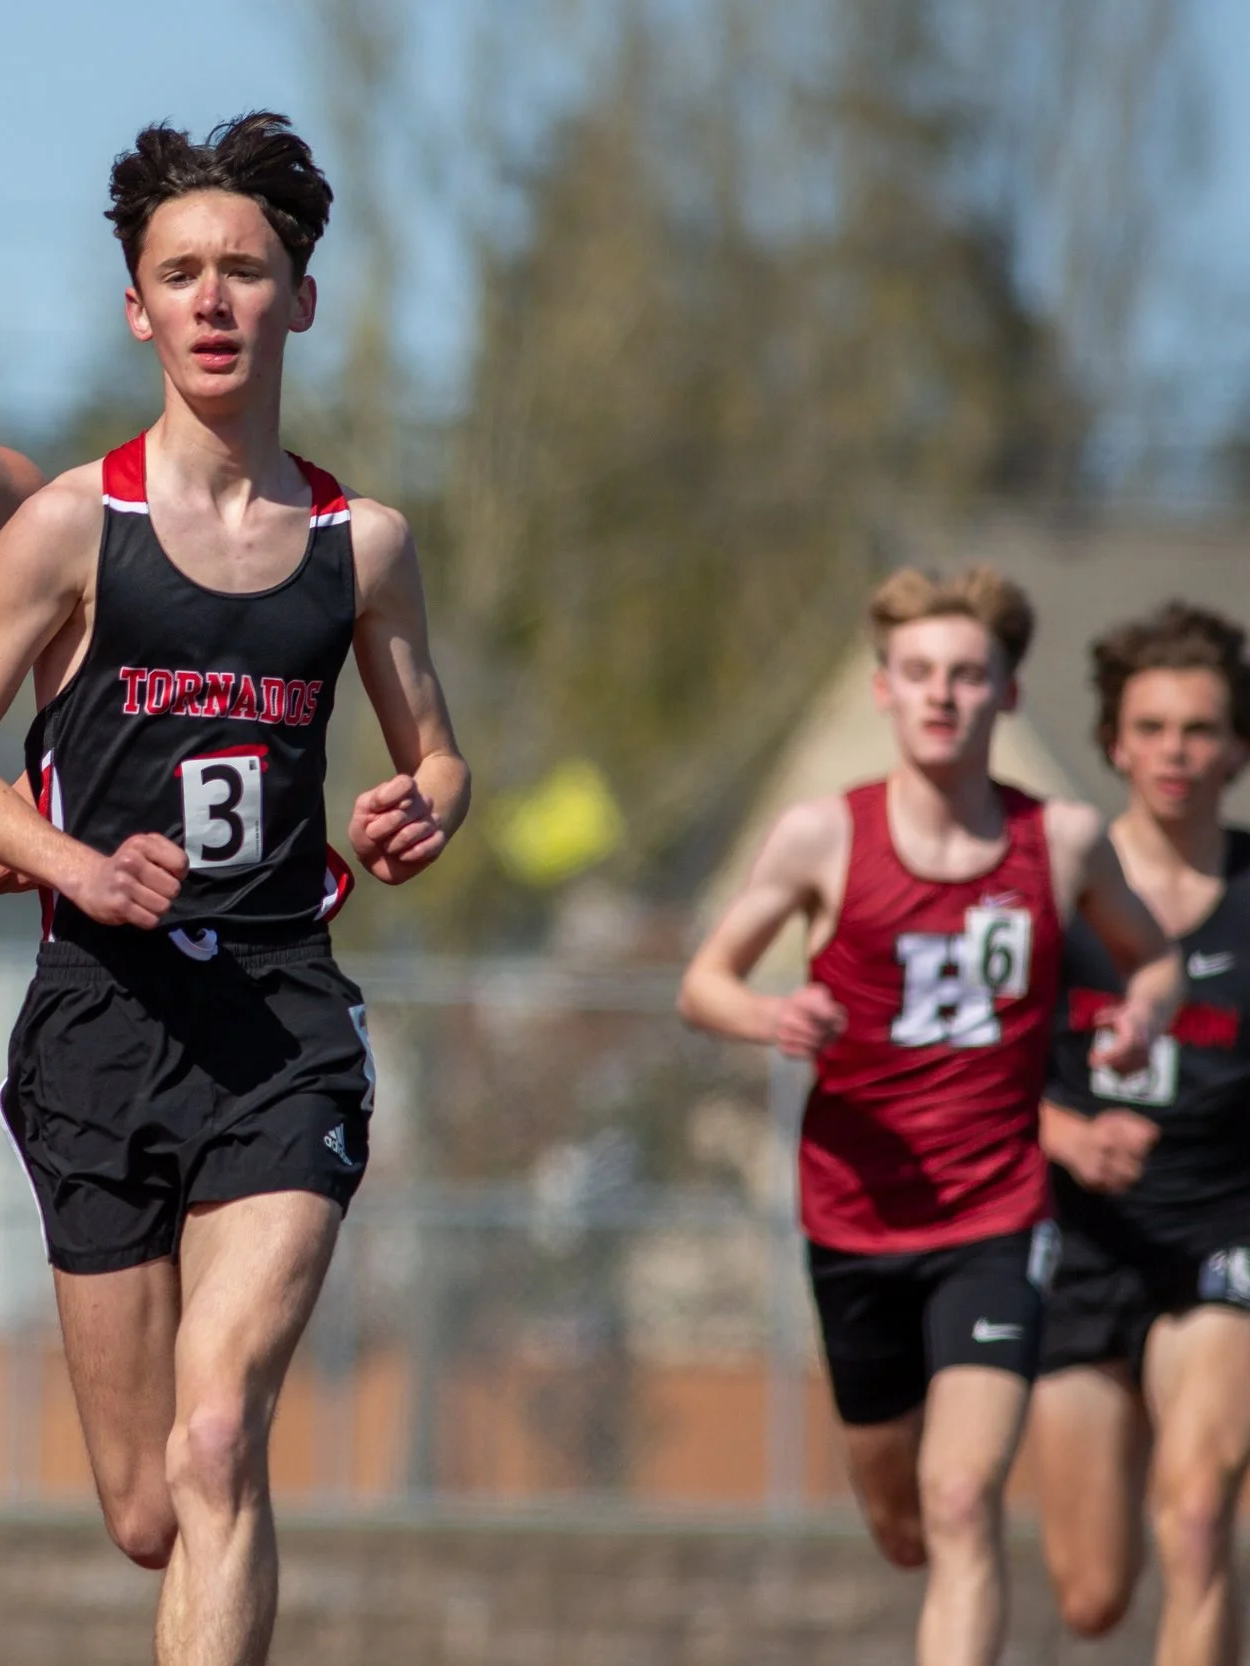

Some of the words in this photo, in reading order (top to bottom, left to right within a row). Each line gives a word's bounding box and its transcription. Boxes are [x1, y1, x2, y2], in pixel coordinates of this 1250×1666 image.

[118, 666, 323, 726] TORNADOS
[200, 764, 244, 862] 3
[891, 933, 1001, 1046] H
[981, 919, 1013, 988] 6
